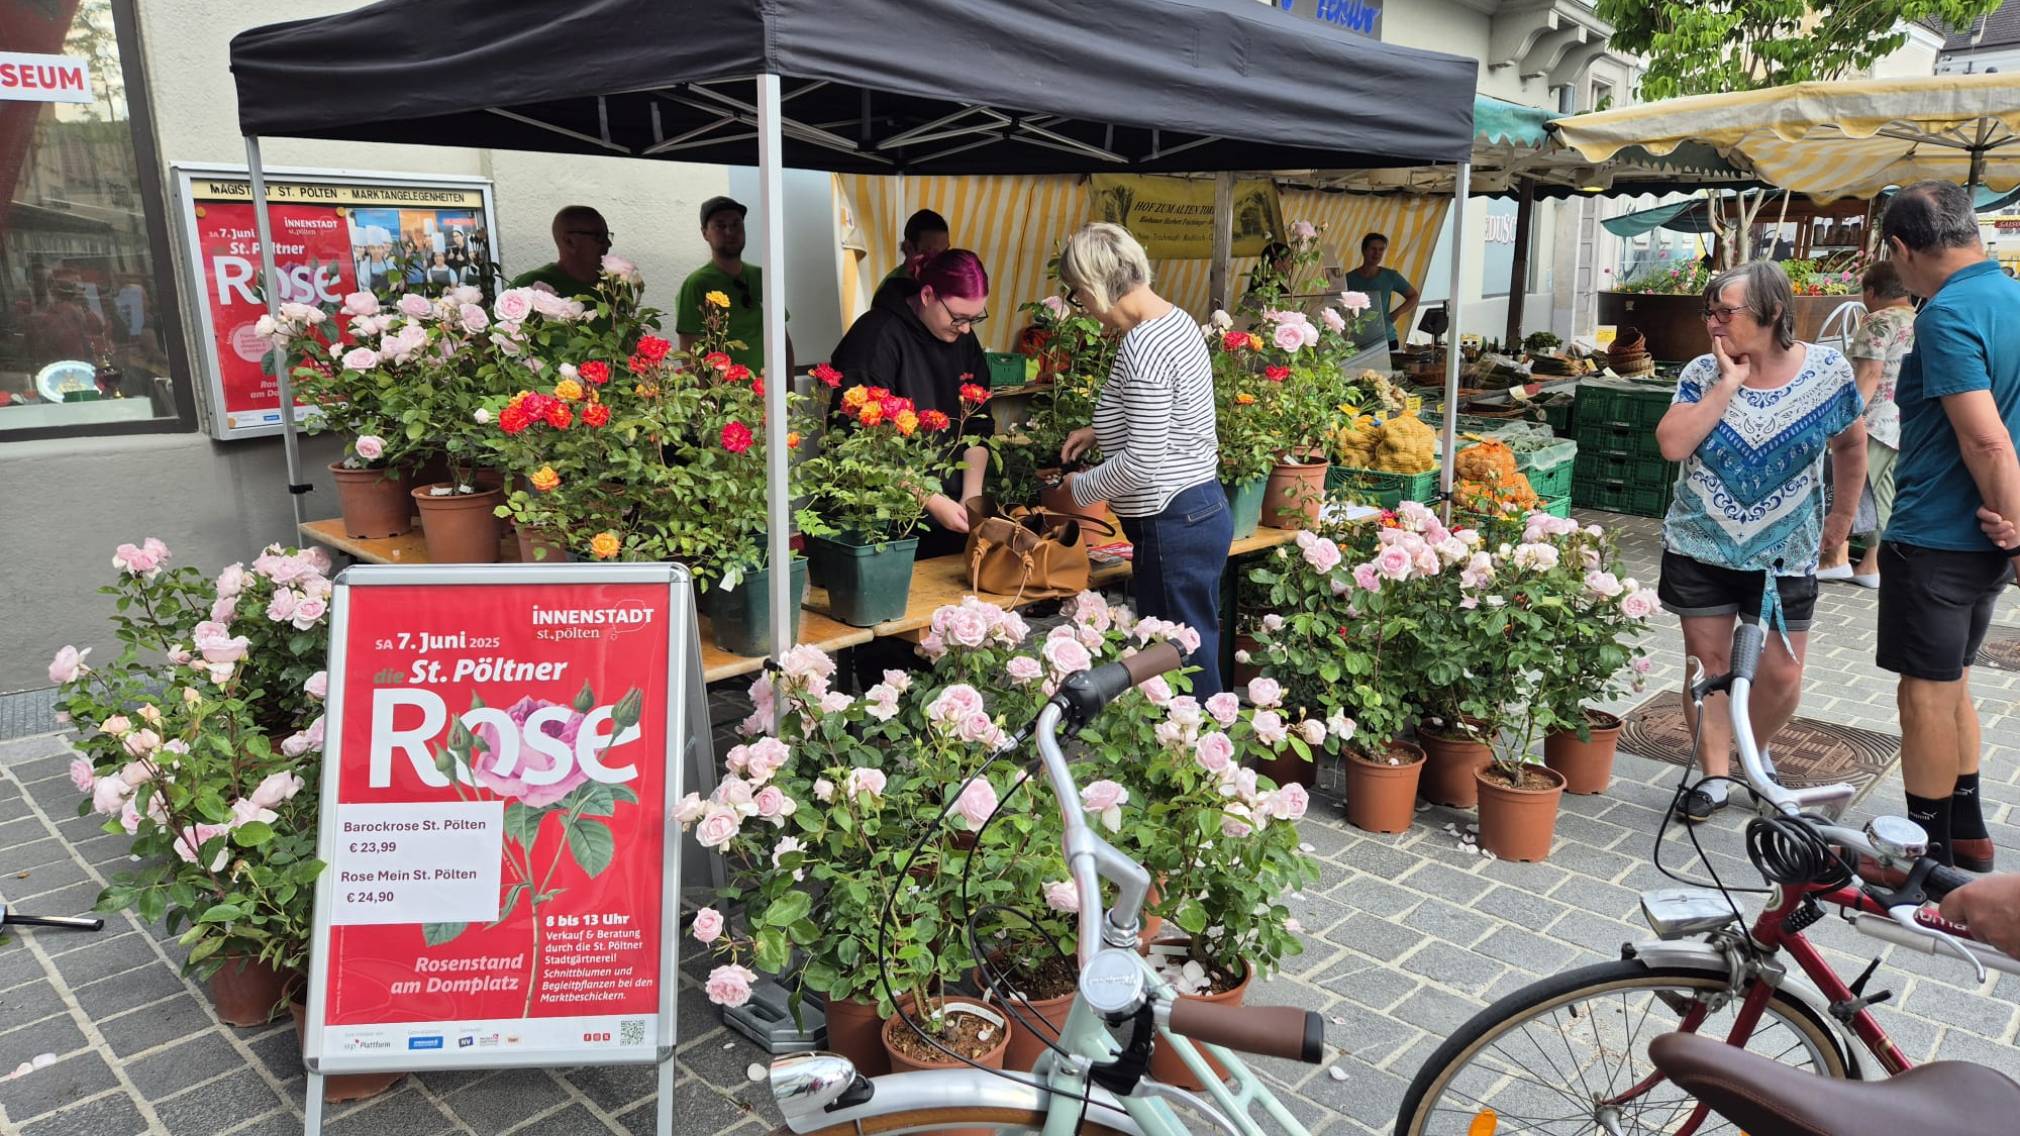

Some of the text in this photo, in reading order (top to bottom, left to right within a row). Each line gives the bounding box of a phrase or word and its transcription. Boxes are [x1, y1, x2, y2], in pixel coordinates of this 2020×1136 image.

[0, 63, 84, 90] SEUM
[210, 184, 271, 196] MAGISTT
[278, 186, 295, 197] ST.
[351, 189, 465, 202] MARKTANGELEGENHEITEN
[220, 228, 231, 238] 7.
[232, 228, 256, 240] Juni
[230, 242, 305, 255] St. Pltner
[375, 631, 500, 654] SA 7. Juni 2025
[373, 657, 568, 684] die St. Pöltner
[369, 687, 642, 788] Rose
[344, 819, 486, 832] Barockrose St. Pölten
[349, 841, 397, 854] € 23,99
[341, 868, 477, 882] Rose Mein St. Pölten
[347, 891, 394, 904] € 24,90
[546, 913, 630, 927] 8 bis 13 Uhr
[546, 929, 641, 941] Verkauf & Beratung
[545, 941, 643, 953] durch die St. Pöltner
[415, 953, 524, 973] Rosenstand
[543, 966, 633, 979] Schnittblumen und
[390, 975, 519, 995] am Domplatz
[542, 978, 653, 992] Begleitpflanzen bei den
[540, 991, 627, 1003] Marktbeschickern.
